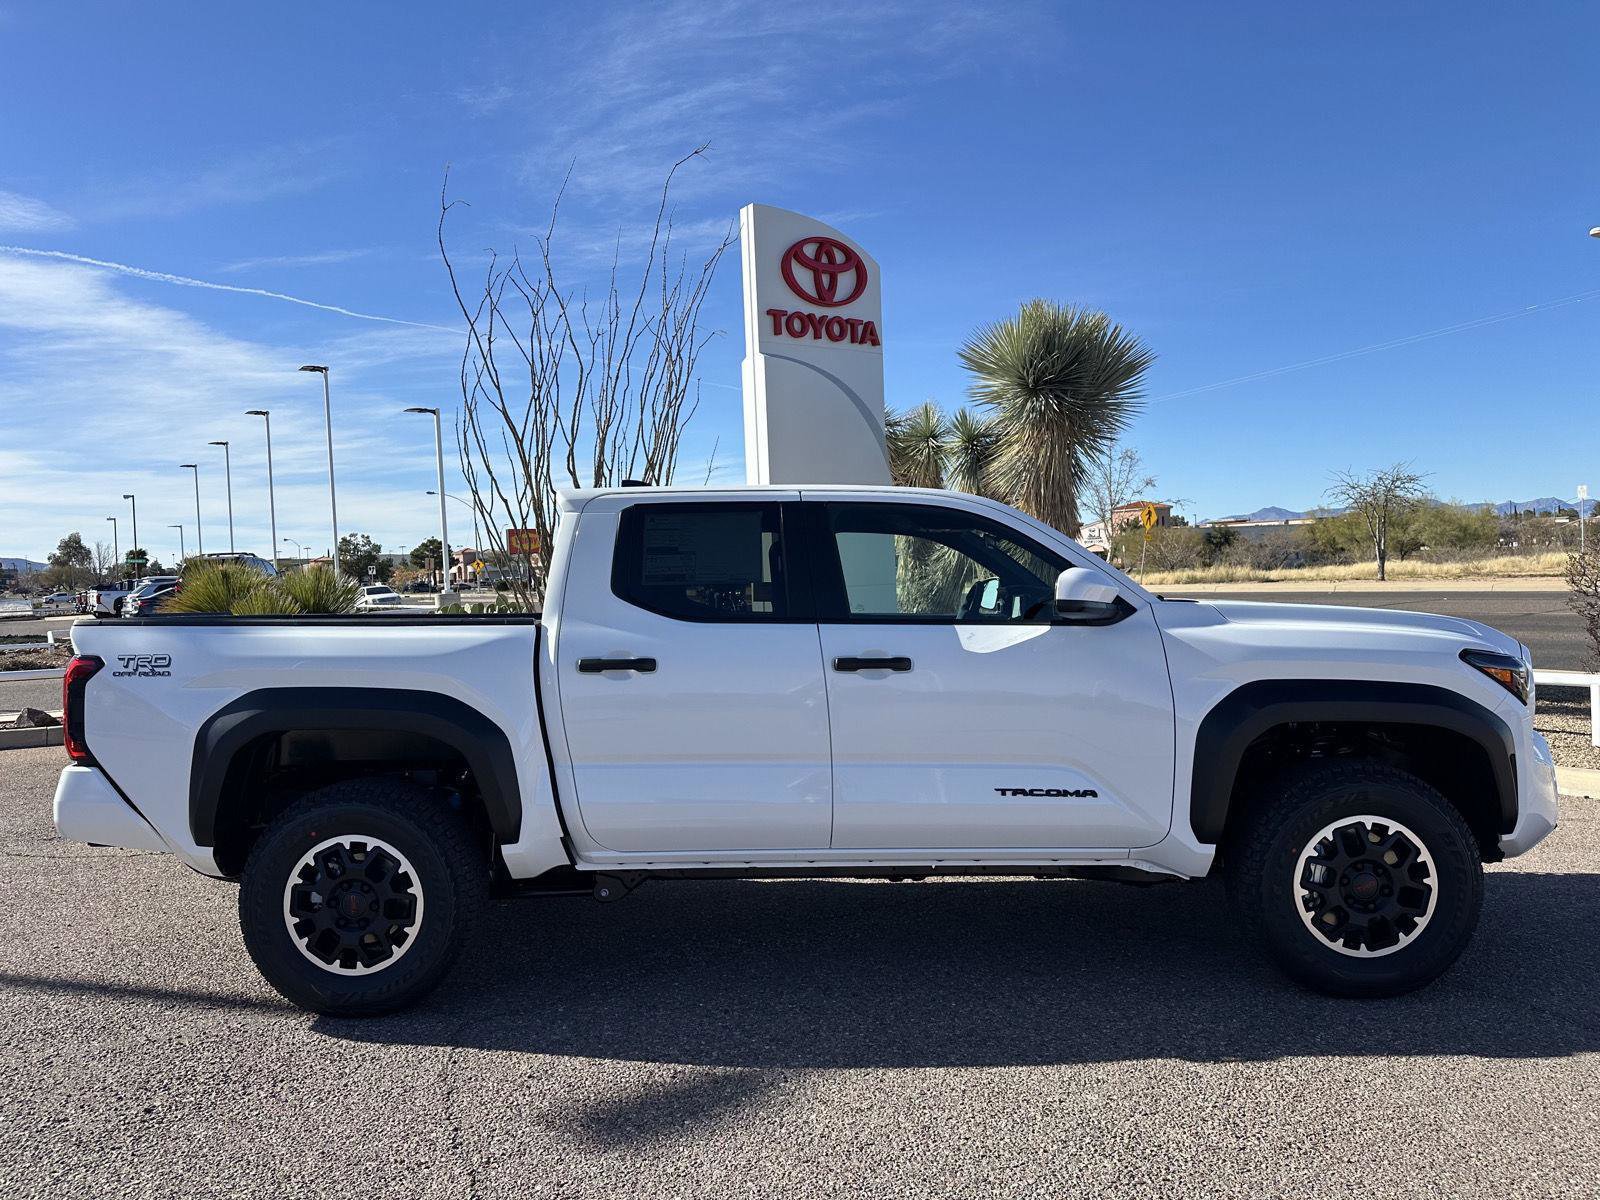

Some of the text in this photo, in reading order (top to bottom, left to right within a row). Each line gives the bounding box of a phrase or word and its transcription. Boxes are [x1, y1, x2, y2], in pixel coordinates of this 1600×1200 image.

[766, 308, 881, 347] TOYOTA
[117, 654, 172, 672] TRD
[994, 788, 1098, 798] TACOMA
